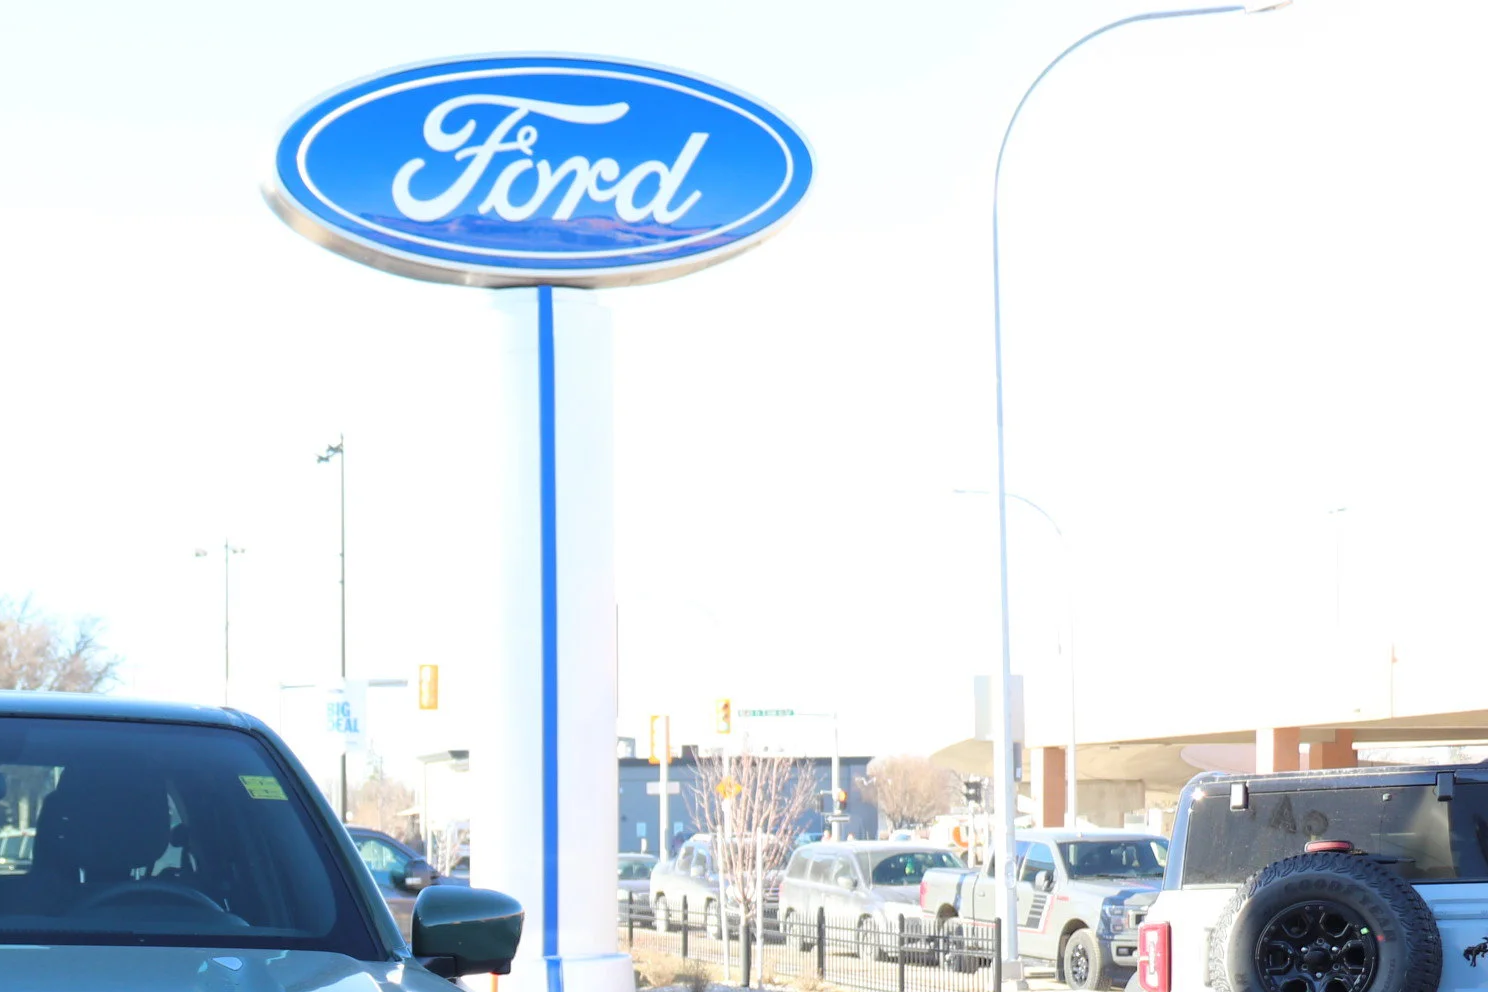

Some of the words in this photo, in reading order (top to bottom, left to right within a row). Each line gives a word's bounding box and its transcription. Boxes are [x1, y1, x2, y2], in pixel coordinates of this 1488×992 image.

[391, 93, 710, 224] Ford
[326, 701, 351, 718] BIG
[326, 717, 360, 734] DEAL
